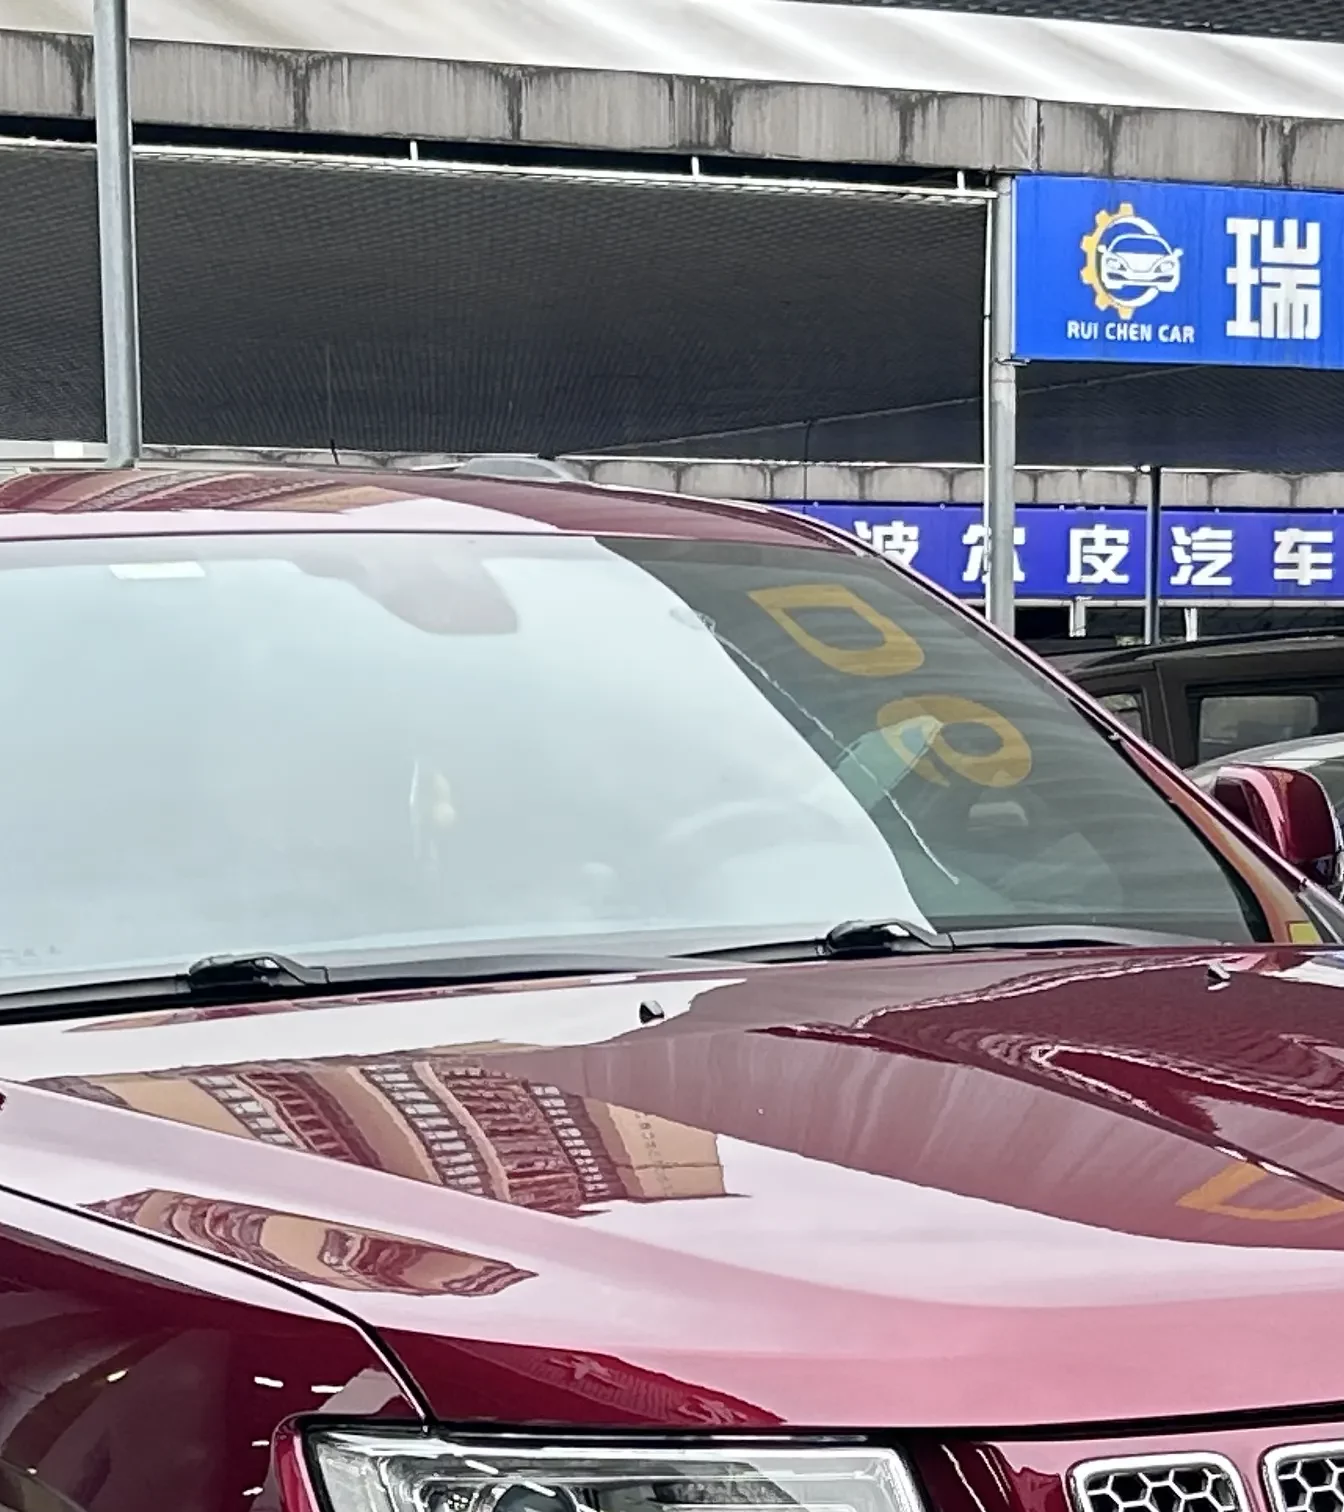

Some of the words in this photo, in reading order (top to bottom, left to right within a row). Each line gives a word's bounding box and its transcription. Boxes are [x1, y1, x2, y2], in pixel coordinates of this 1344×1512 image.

[1067, 320, 1099, 339] RUI
[1105, 322, 1152, 342] CHEN
[1158, 324, 1195, 344] CAR
